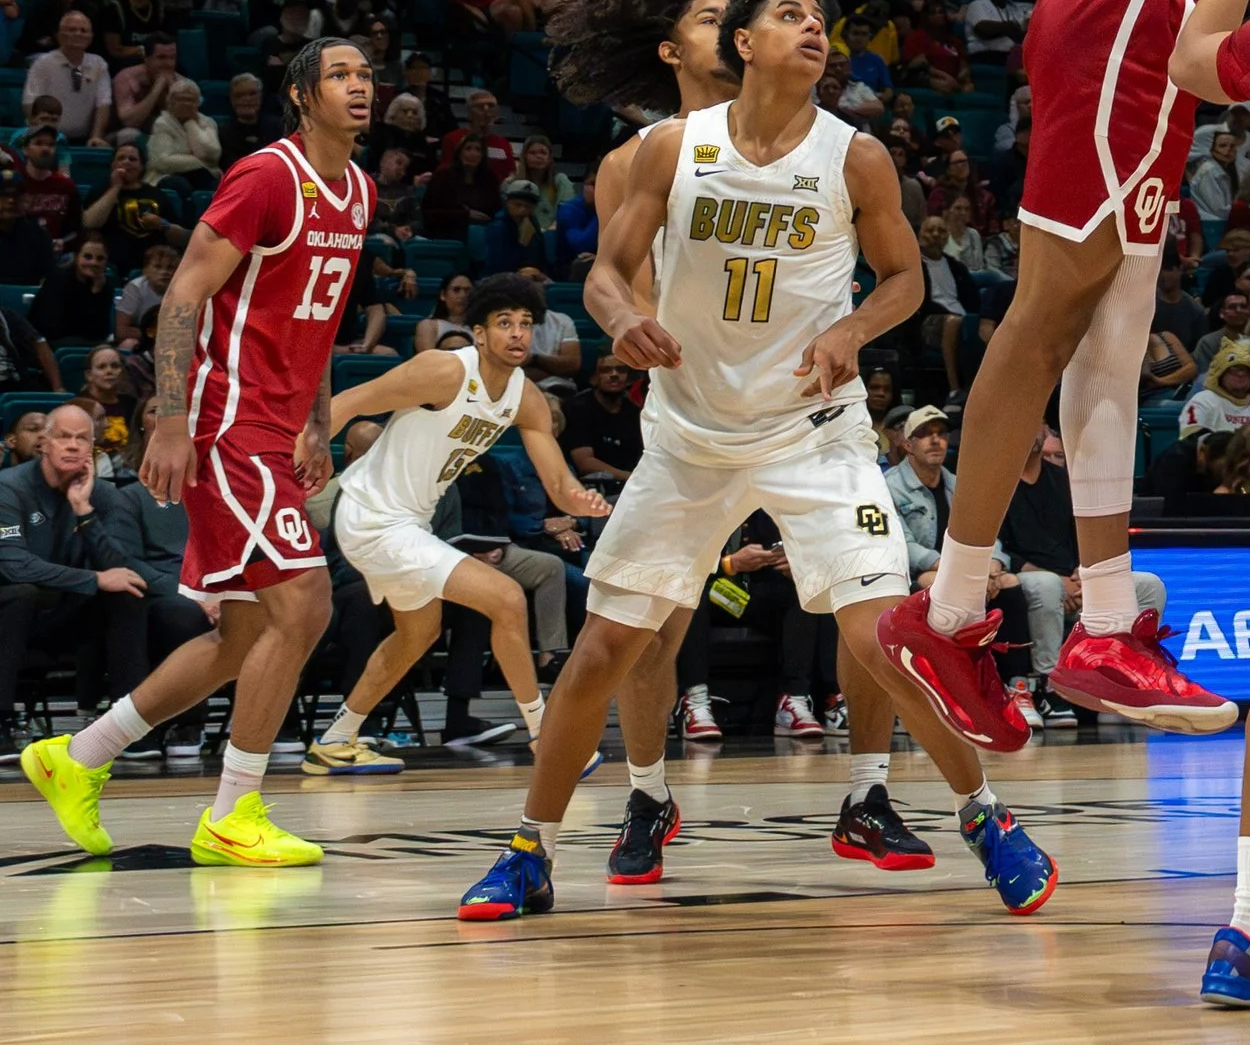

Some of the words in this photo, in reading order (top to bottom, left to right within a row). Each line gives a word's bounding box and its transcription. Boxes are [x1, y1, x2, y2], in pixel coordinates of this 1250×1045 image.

[690, 196, 820, 250] BUFFS
[1134, 177, 1165, 234] OU
[307, 230, 363, 251] OKLAHOMA
[292, 256, 351, 321] 13
[722, 257, 778, 322] 11
[275, 507, 312, 552] OU
